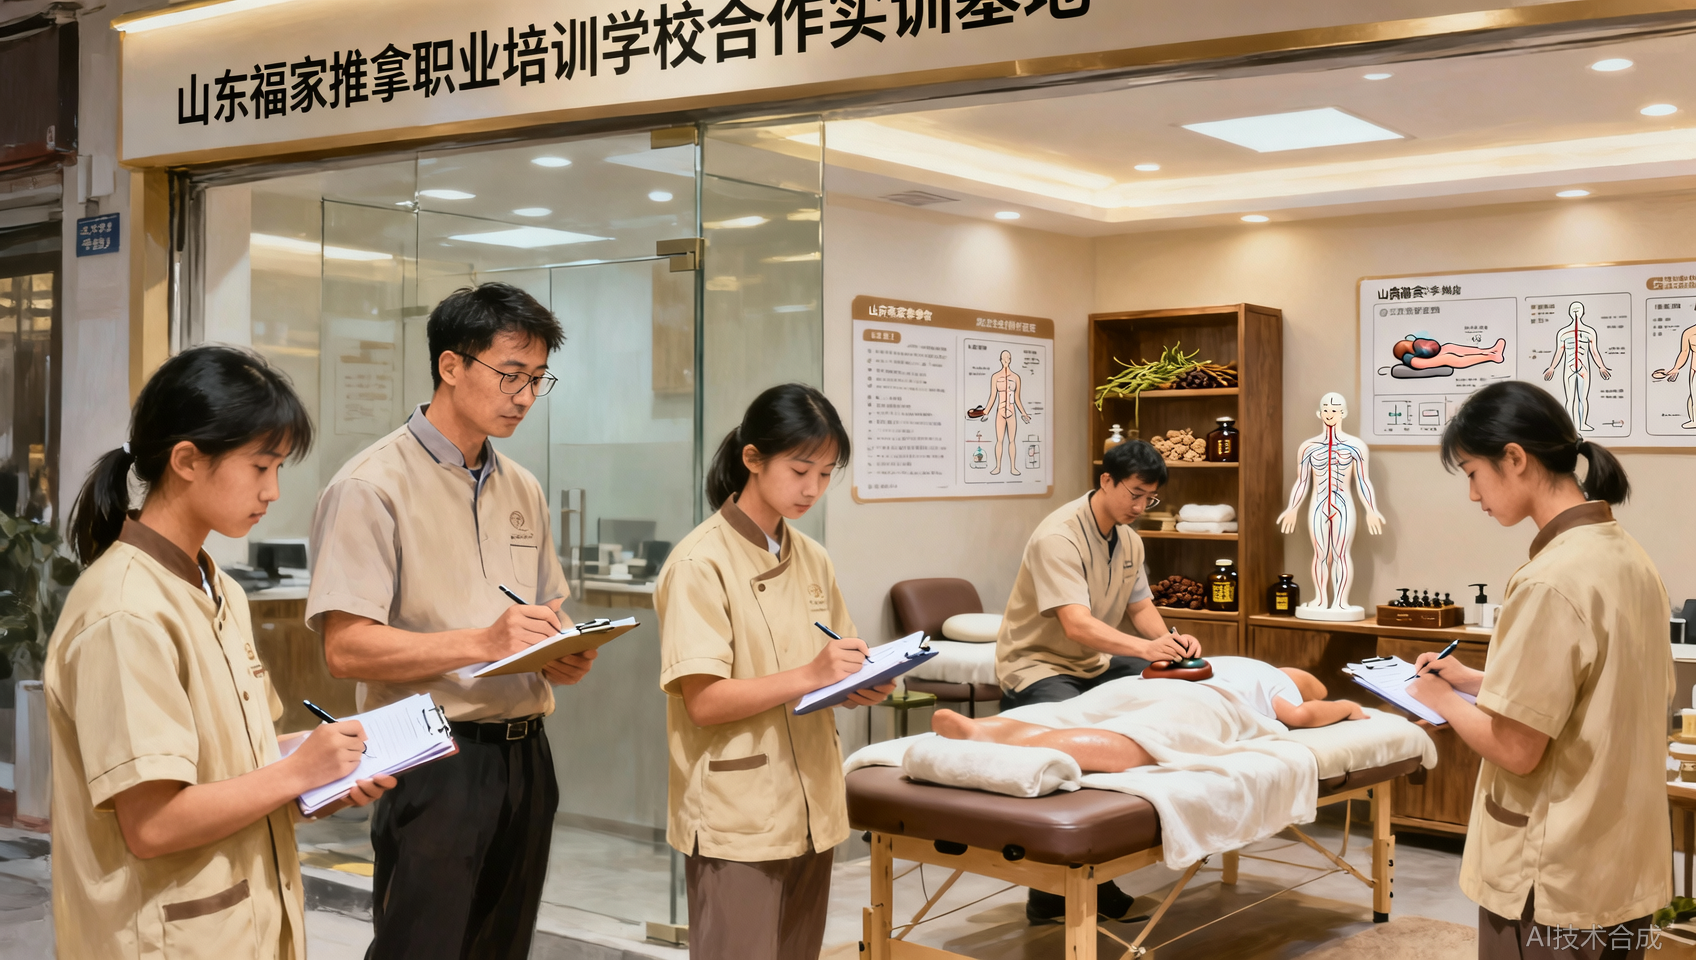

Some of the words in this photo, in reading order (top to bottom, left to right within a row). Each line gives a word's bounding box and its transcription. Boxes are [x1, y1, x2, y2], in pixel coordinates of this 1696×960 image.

[178, 0, 1090, 126] 山东福家推拿职业培训学校合作实训
